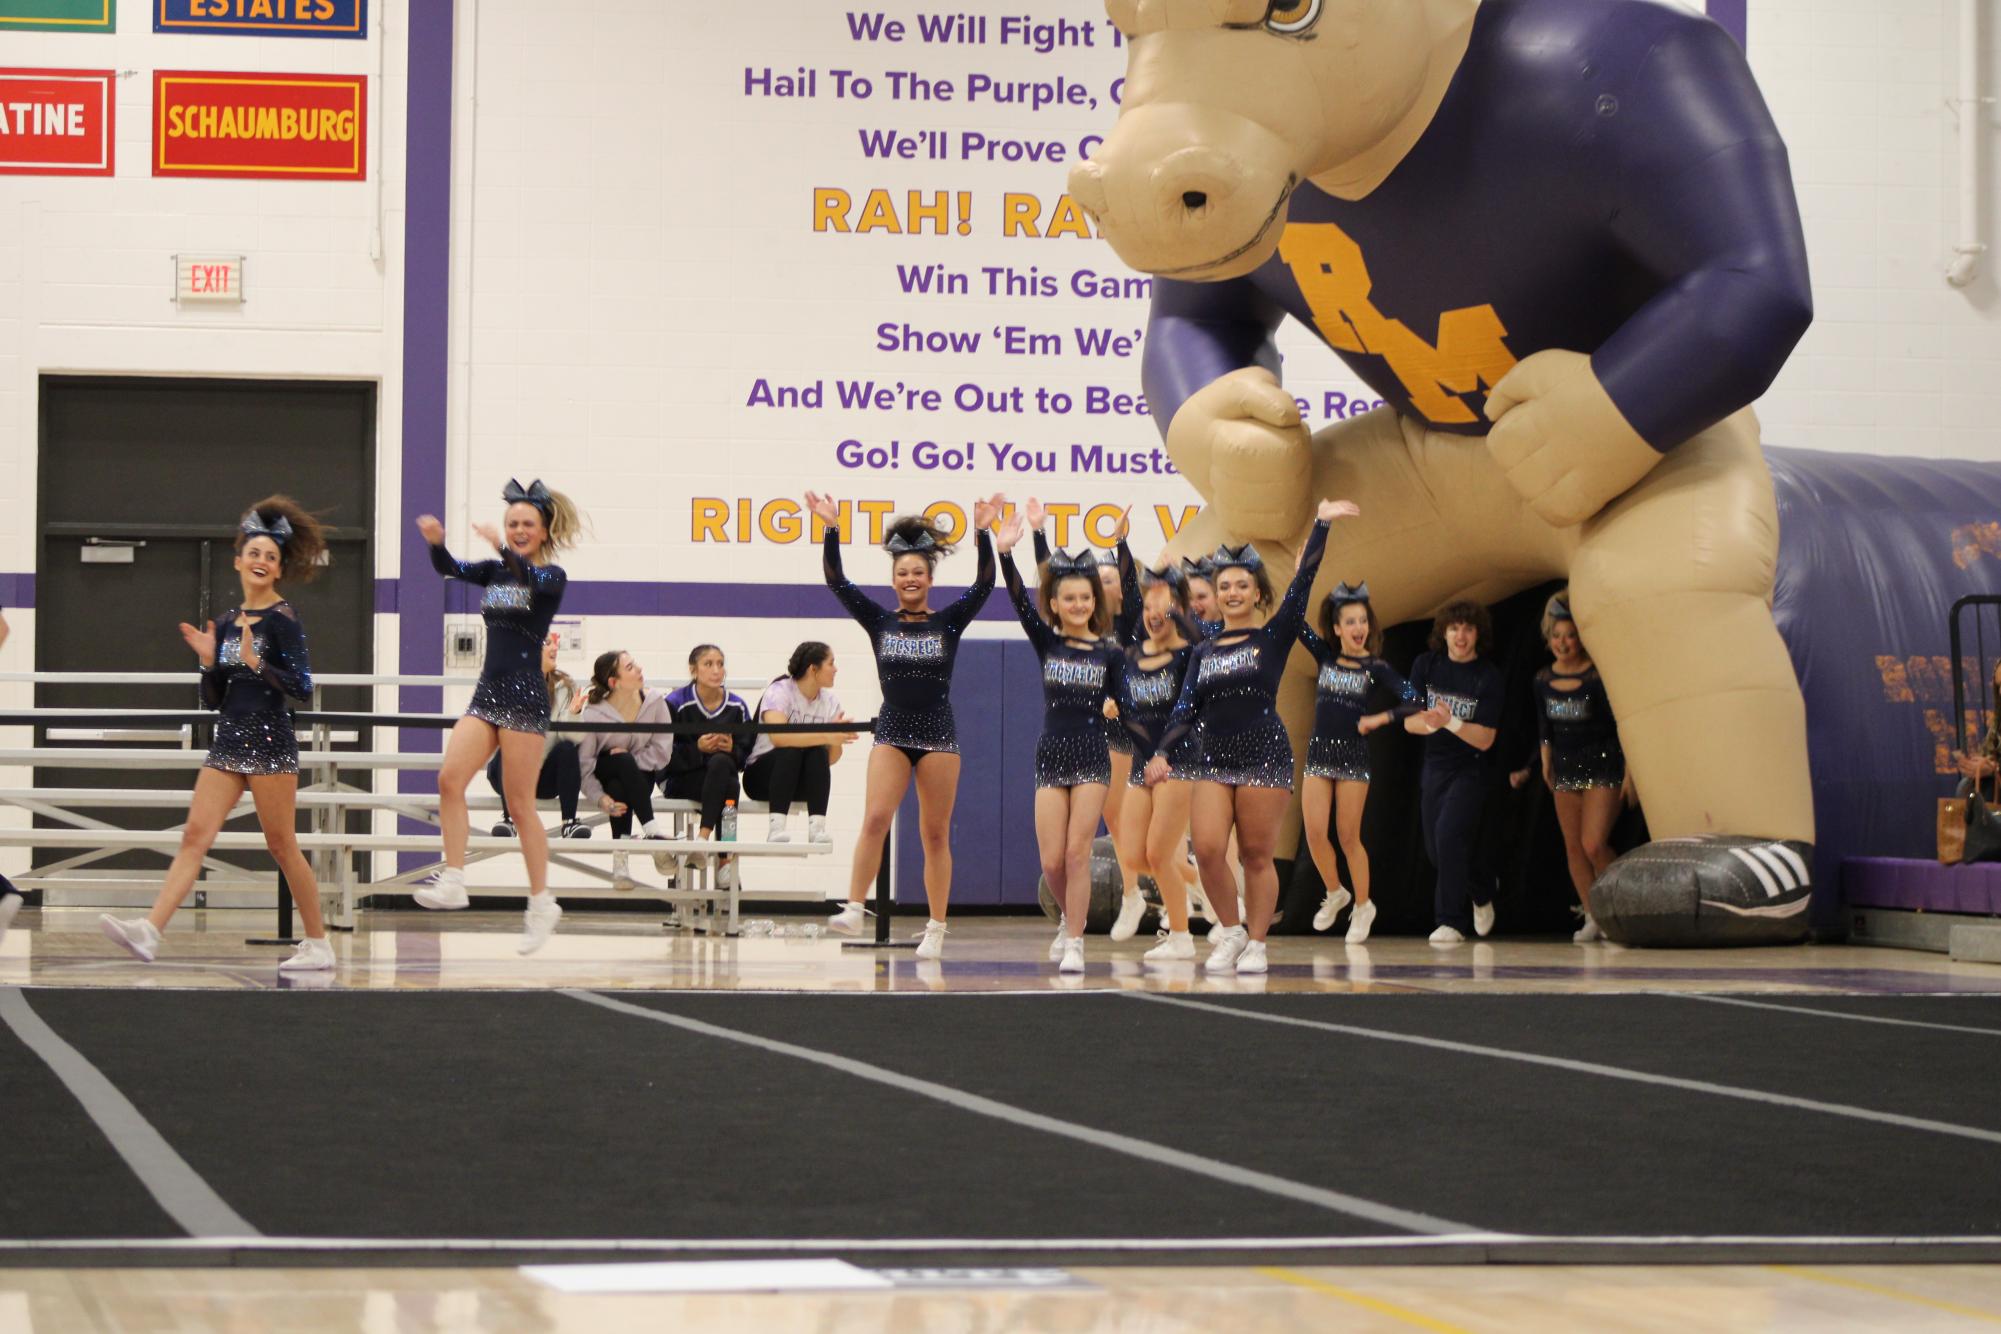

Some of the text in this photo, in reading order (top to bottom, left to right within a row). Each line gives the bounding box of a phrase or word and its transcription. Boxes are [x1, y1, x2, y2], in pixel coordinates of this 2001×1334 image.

[190, 0, 335, 20] ESTATES
[847, 12, 906, 42] We
[918, 15, 987, 45] Will
[1001, 16, 1095, 53] Fight
[744, 67, 817, 97] Hail
[830, 69, 874, 99] To
[885, 71, 954, 102] The
[967, 73, 1098, 112] Purple,
[168, 104, 355, 142] SCHAUMBURG
[961, 131, 1067, 163] Prove
[813, 187, 1105, 239] RAH! RA
[191, 264, 230, 293] EXIT
[897, 264, 970, 294] Win
[981, 266, 1059, 297] This
[877, 322, 981, 354] Show
[746, 378, 824, 409] And
[954, 383, 1025, 414] Out
[1035, 387, 1073, 414] to
[1324, 391, 1386, 419] Re
[836, 439, 900, 470] Go!
[911, 441, 975, 472] Go!
[988, 443, 1057, 473] You
[691, 497, 895, 545] RIGHT
[1043, 502, 1147, 549] TO
